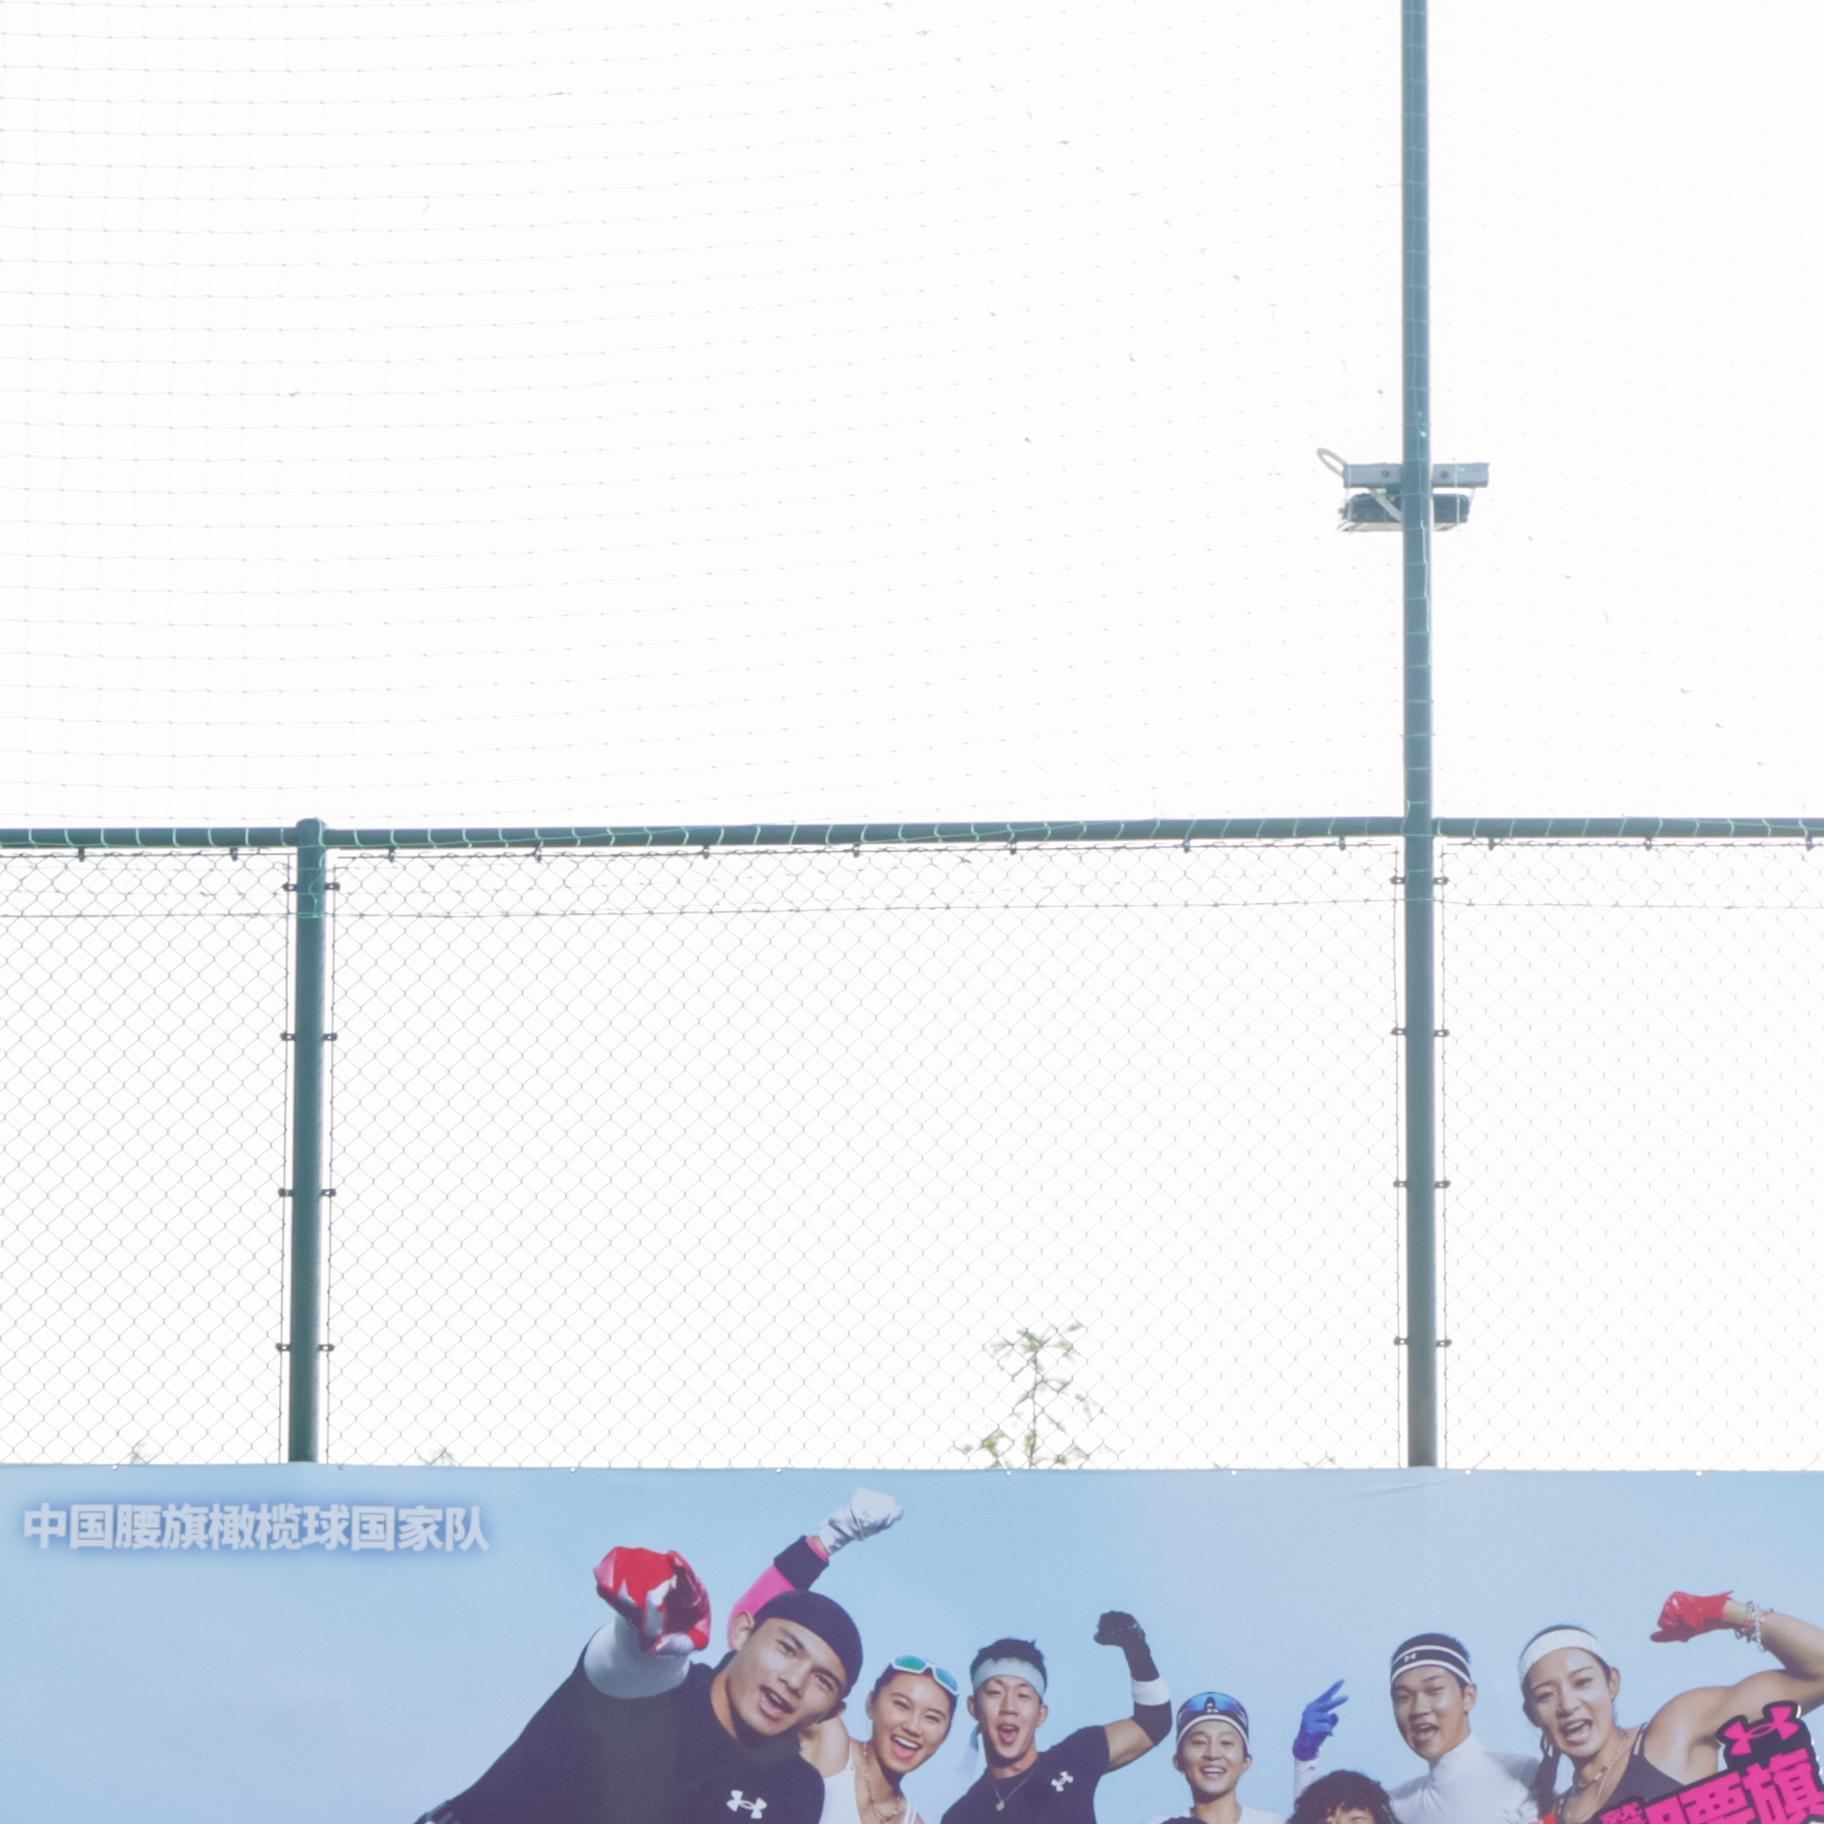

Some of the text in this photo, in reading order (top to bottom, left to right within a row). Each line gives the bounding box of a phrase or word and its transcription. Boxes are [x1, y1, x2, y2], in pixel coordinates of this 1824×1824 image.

[23, 1503, 491, 1552] 中国腰旗橄榄球国家队
